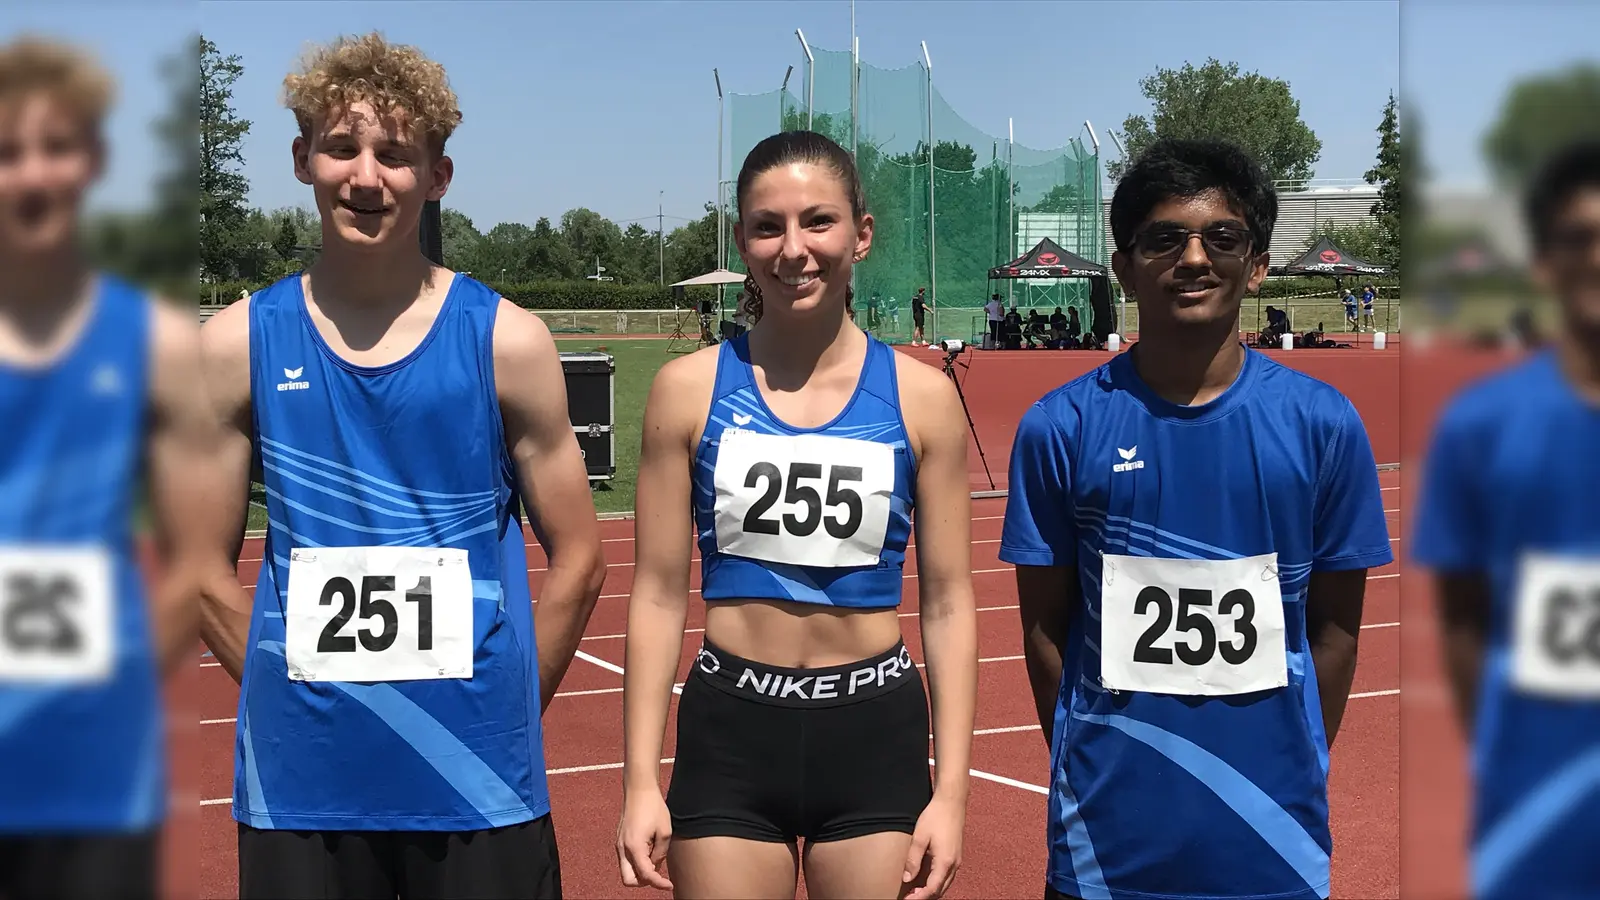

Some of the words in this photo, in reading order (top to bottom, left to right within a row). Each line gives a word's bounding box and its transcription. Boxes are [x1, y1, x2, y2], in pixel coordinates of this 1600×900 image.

[277, 380, 309, 391] erima
[1113, 460, 1144, 472] erima
[742, 461, 863, 539] 255
[317, 575, 432, 652] 251
[1133, 585, 1258, 666] 253
[736, 667, 842, 700] NIKE
[848, 645, 912, 695] PRO
